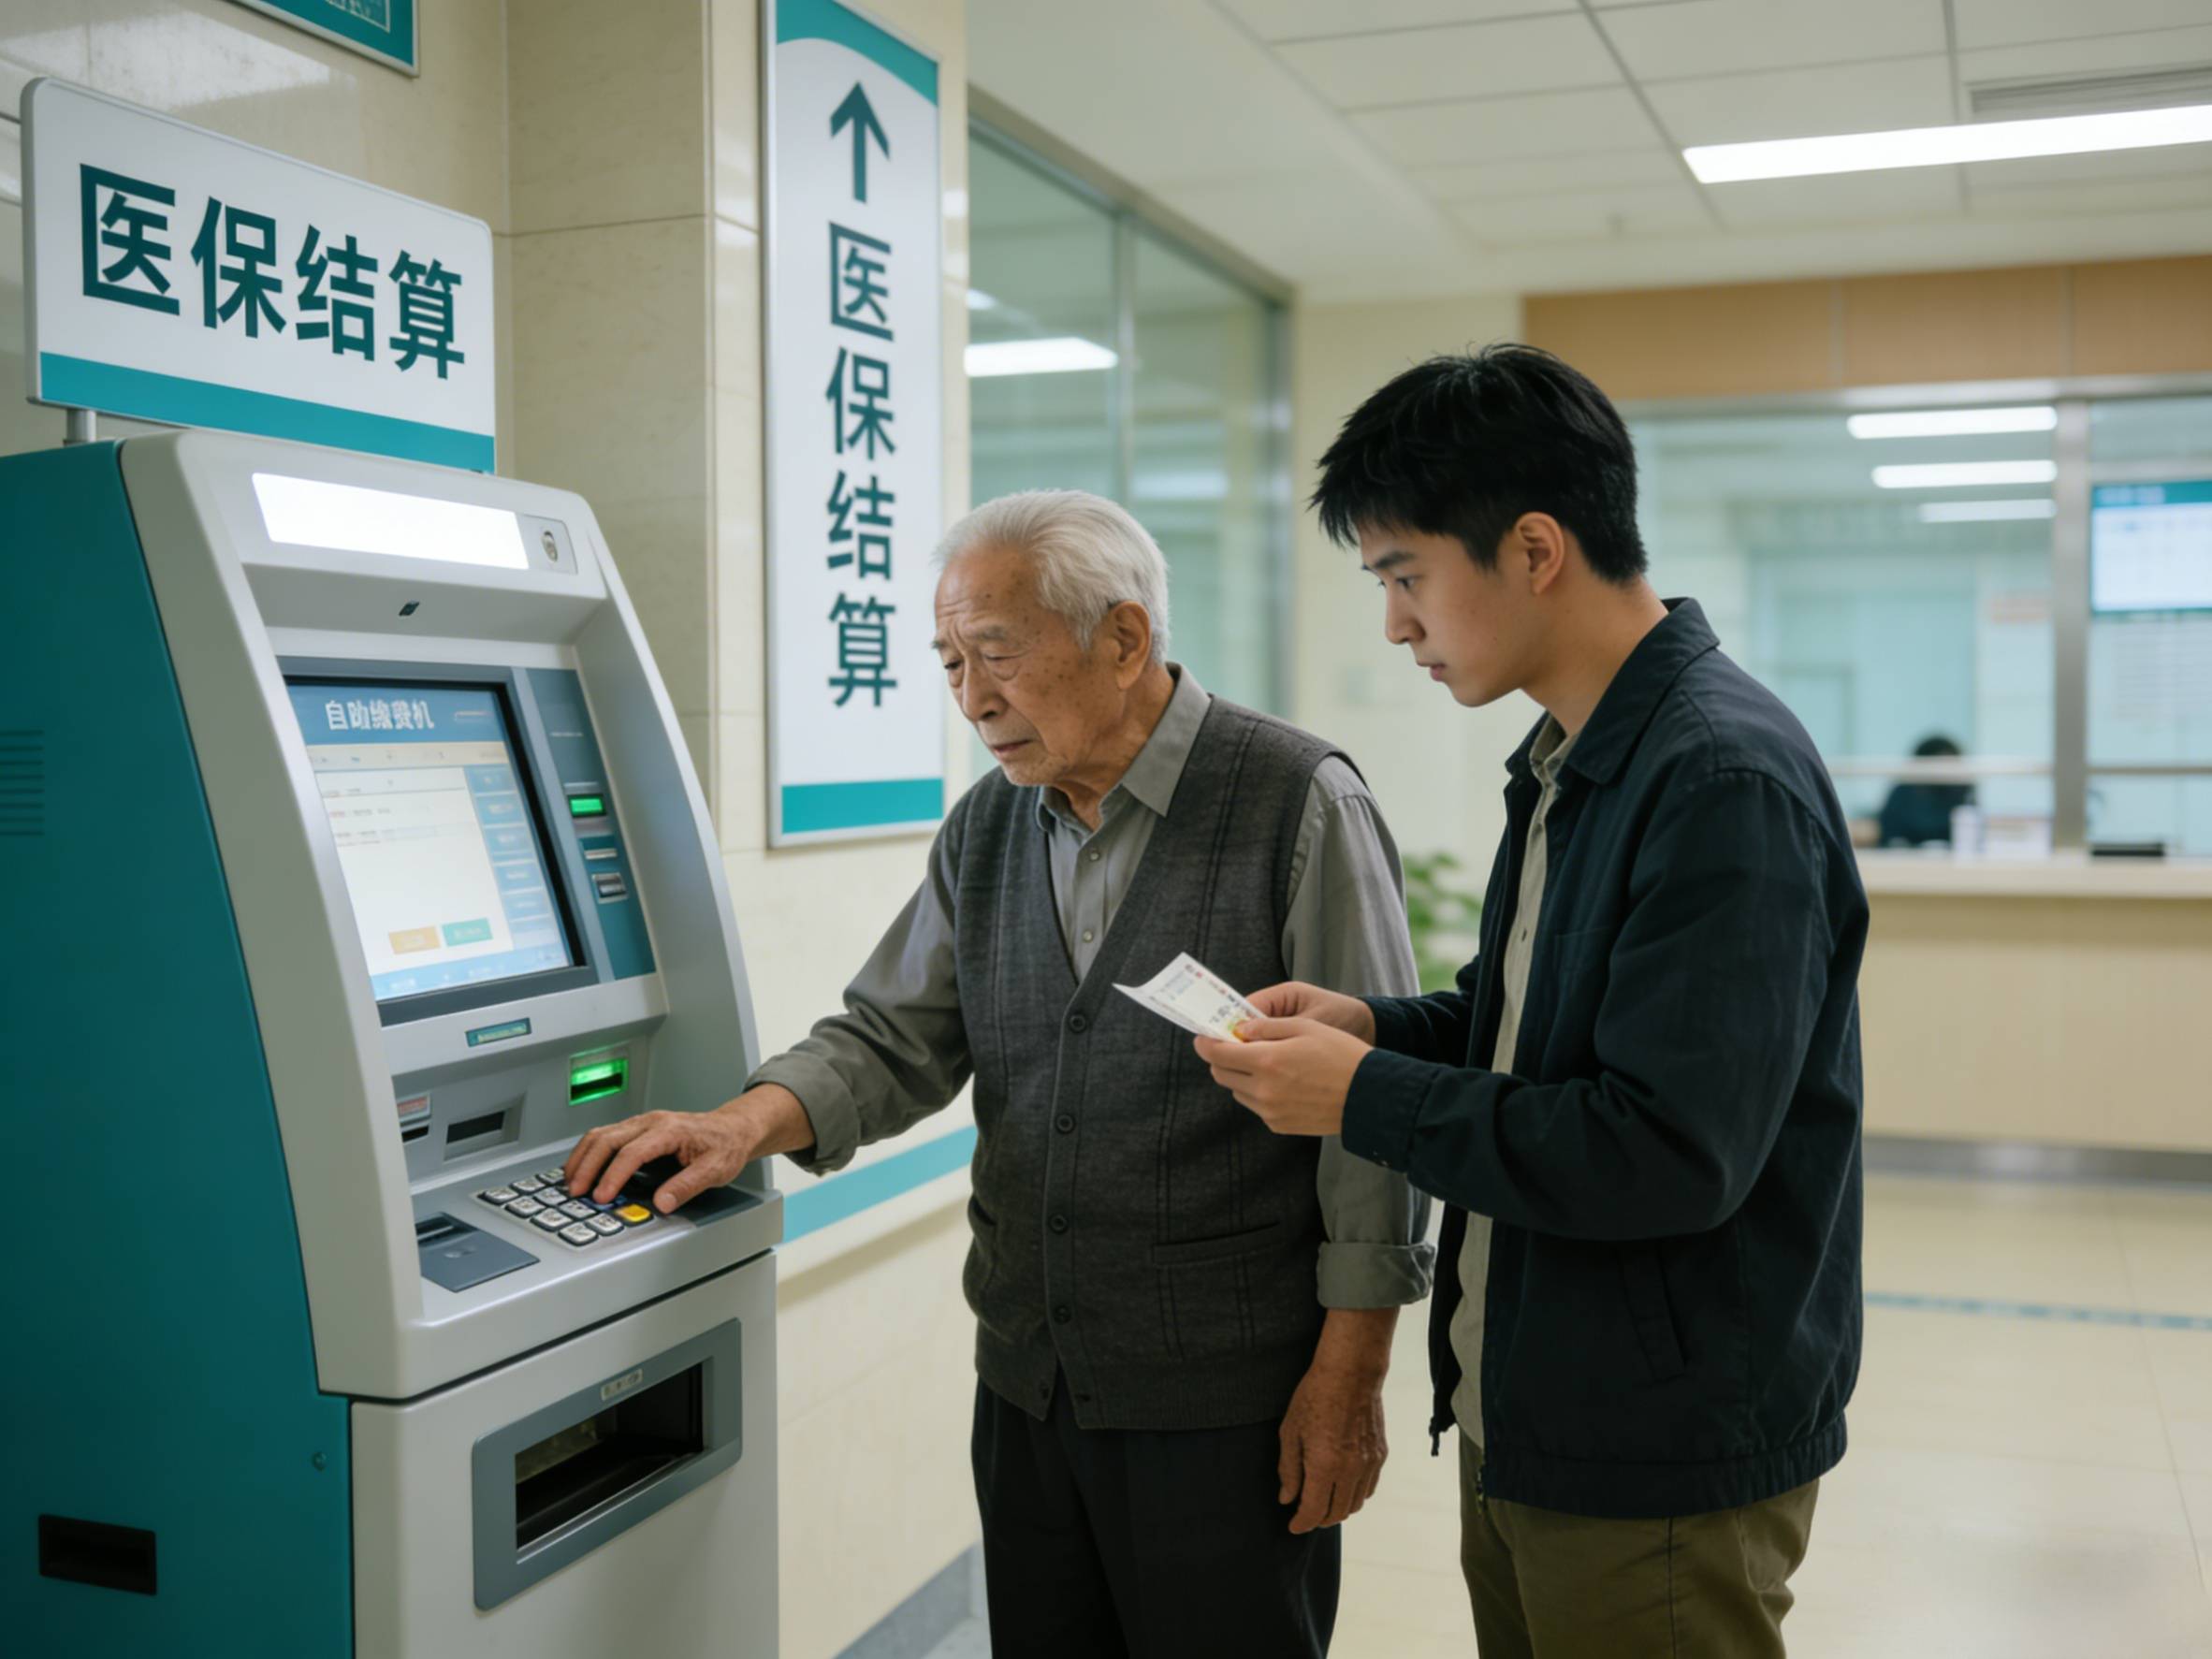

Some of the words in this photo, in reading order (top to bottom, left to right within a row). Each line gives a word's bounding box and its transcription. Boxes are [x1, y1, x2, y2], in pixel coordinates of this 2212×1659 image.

[80, 163, 465, 379] 医保结算
[825, 221, 897, 708] 医保结算
